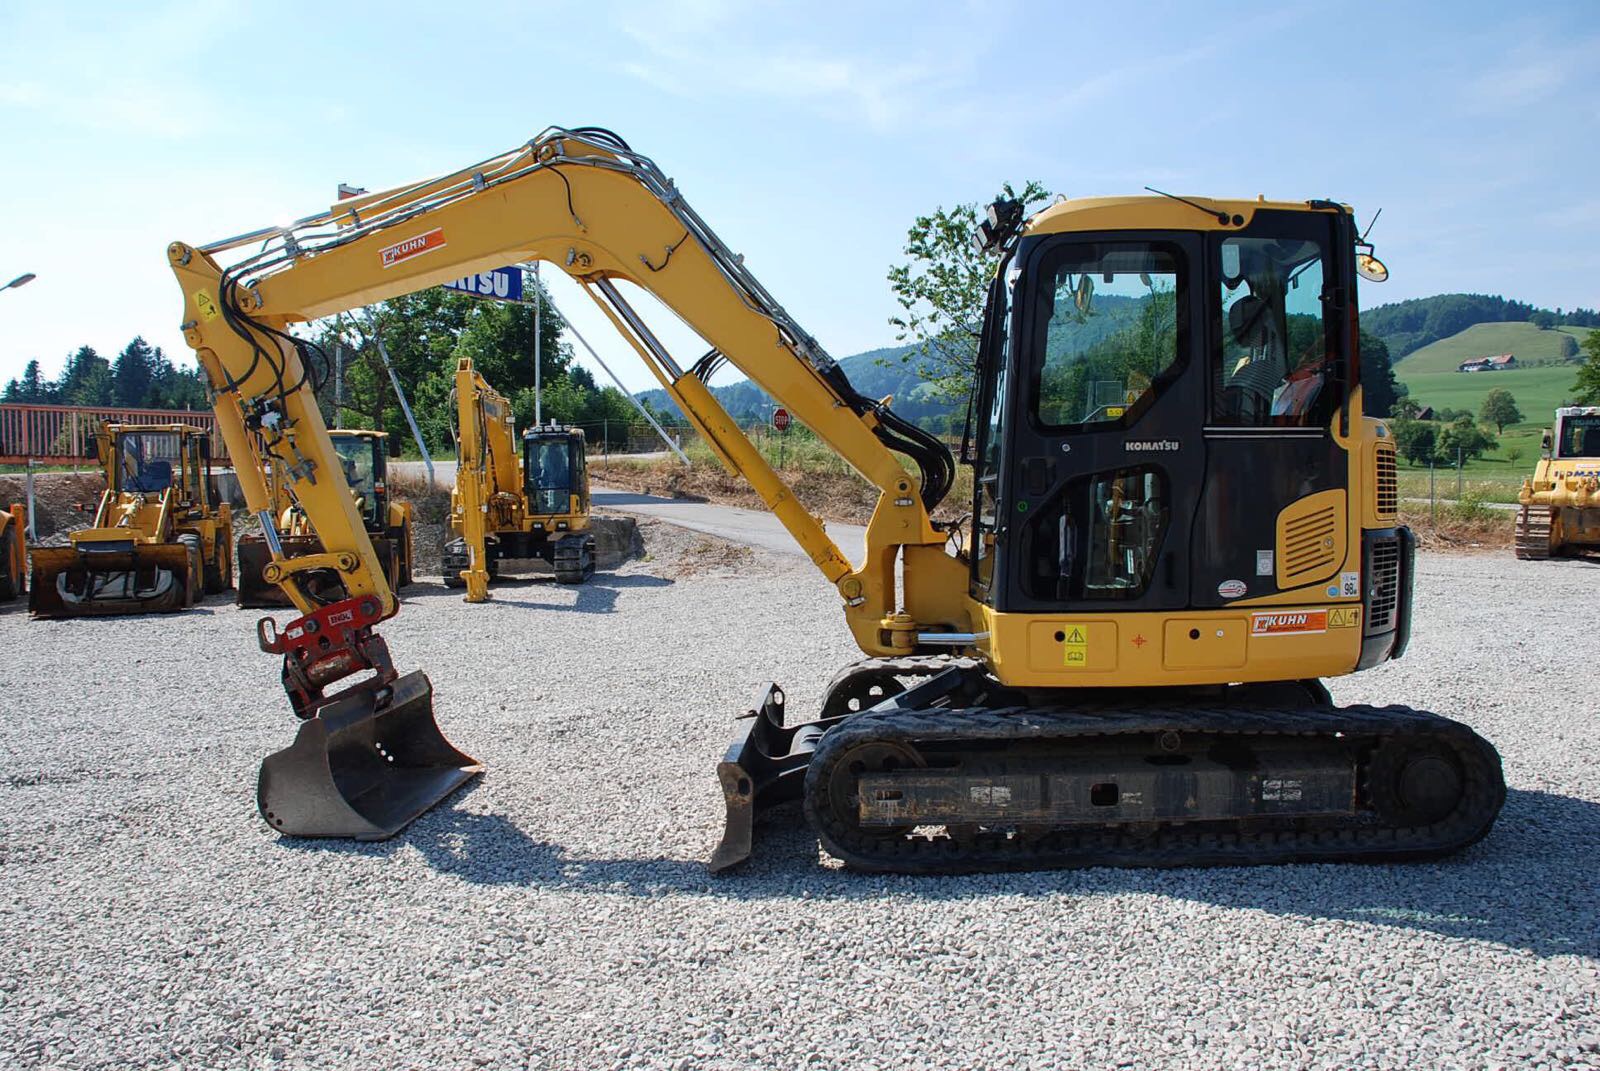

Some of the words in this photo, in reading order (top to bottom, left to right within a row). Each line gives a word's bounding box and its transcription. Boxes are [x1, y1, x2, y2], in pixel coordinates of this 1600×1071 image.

[393, 237, 426, 254] KUHN
[775, 416, 788, 425] STOP
[1125, 440, 1179, 451] KOMATSU
[1269, 615, 1307, 625] KUHN
